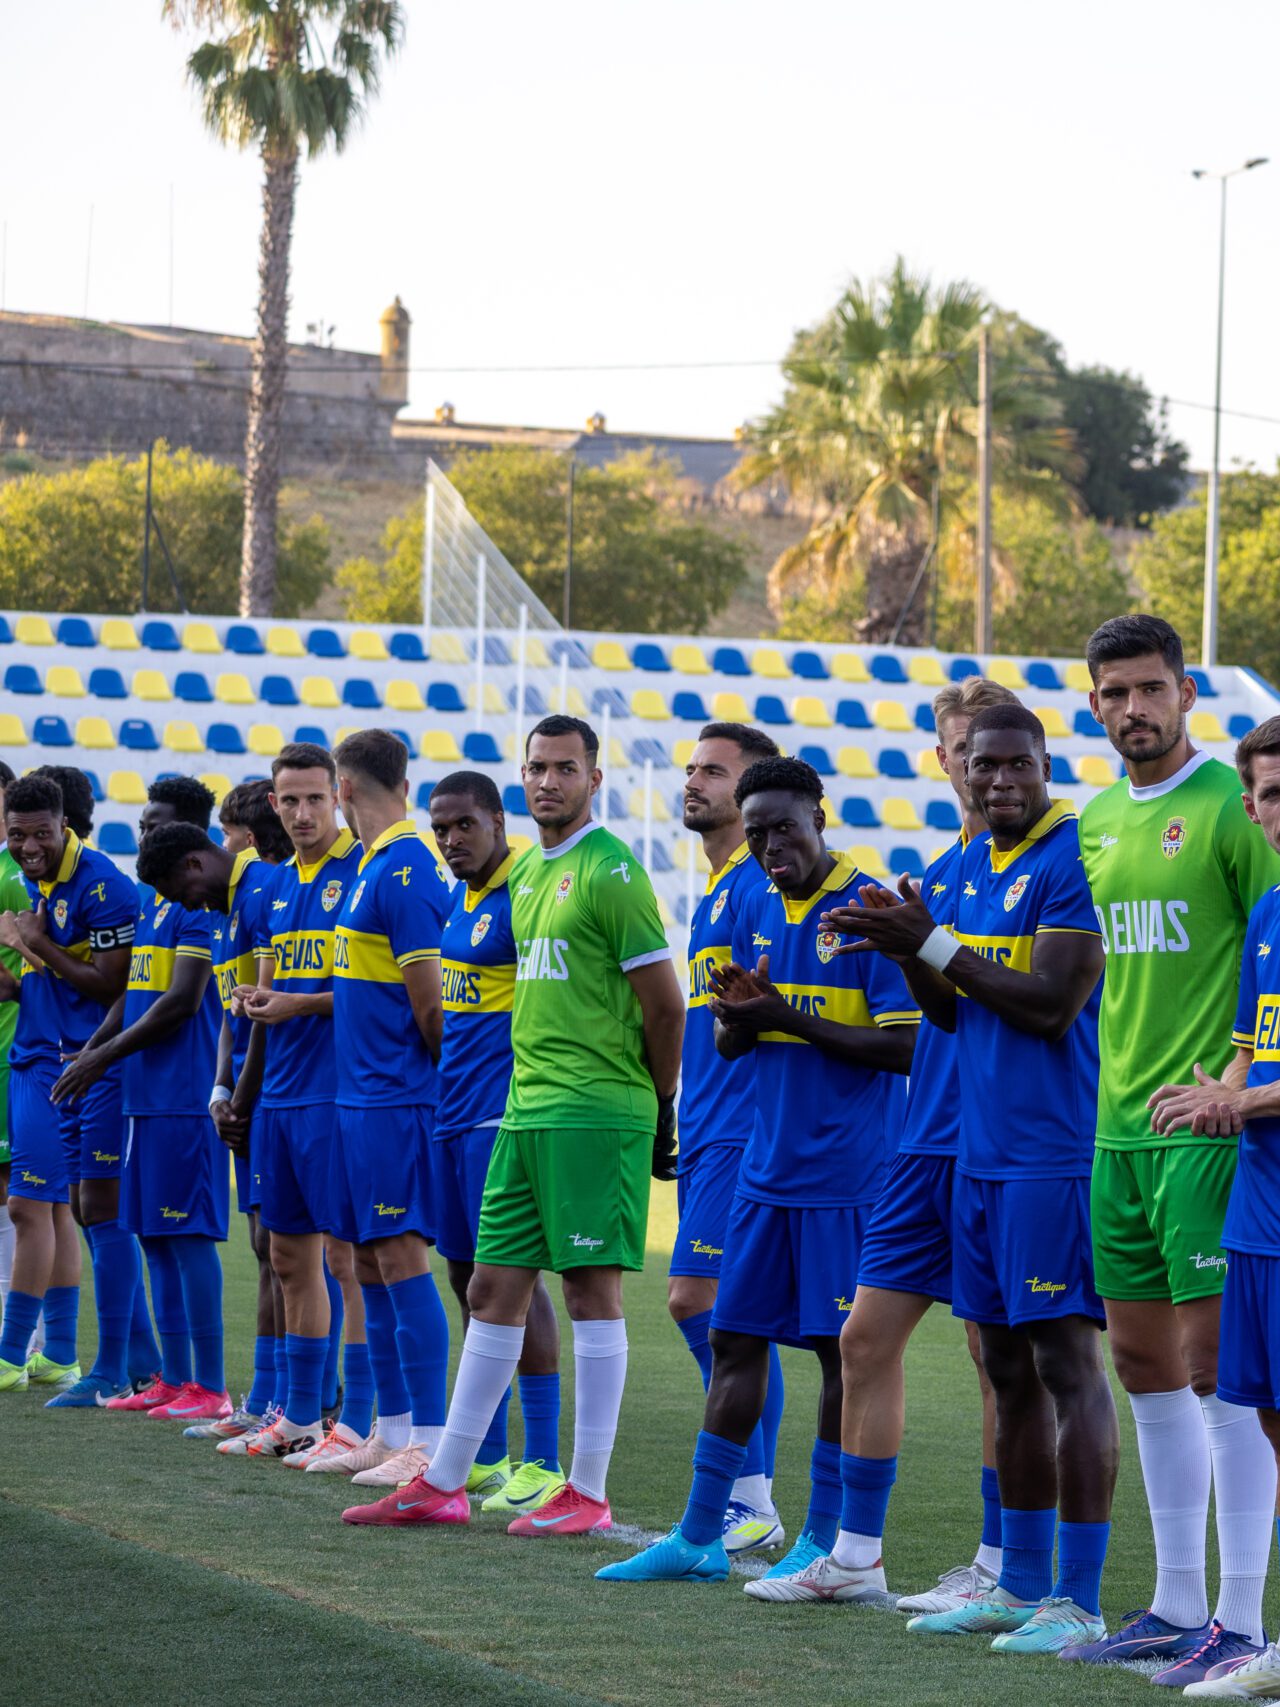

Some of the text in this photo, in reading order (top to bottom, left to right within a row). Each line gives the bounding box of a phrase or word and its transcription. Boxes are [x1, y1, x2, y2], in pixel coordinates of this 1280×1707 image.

[1110, 900, 1190, 954] ELVAS
[568, 1233, 604, 1251] tactique
[690, 1239, 723, 1260] tactique
[1189, 1252, 1226, 1272] tactiqu
[1025, 1276, 1067, 1298] tactique
